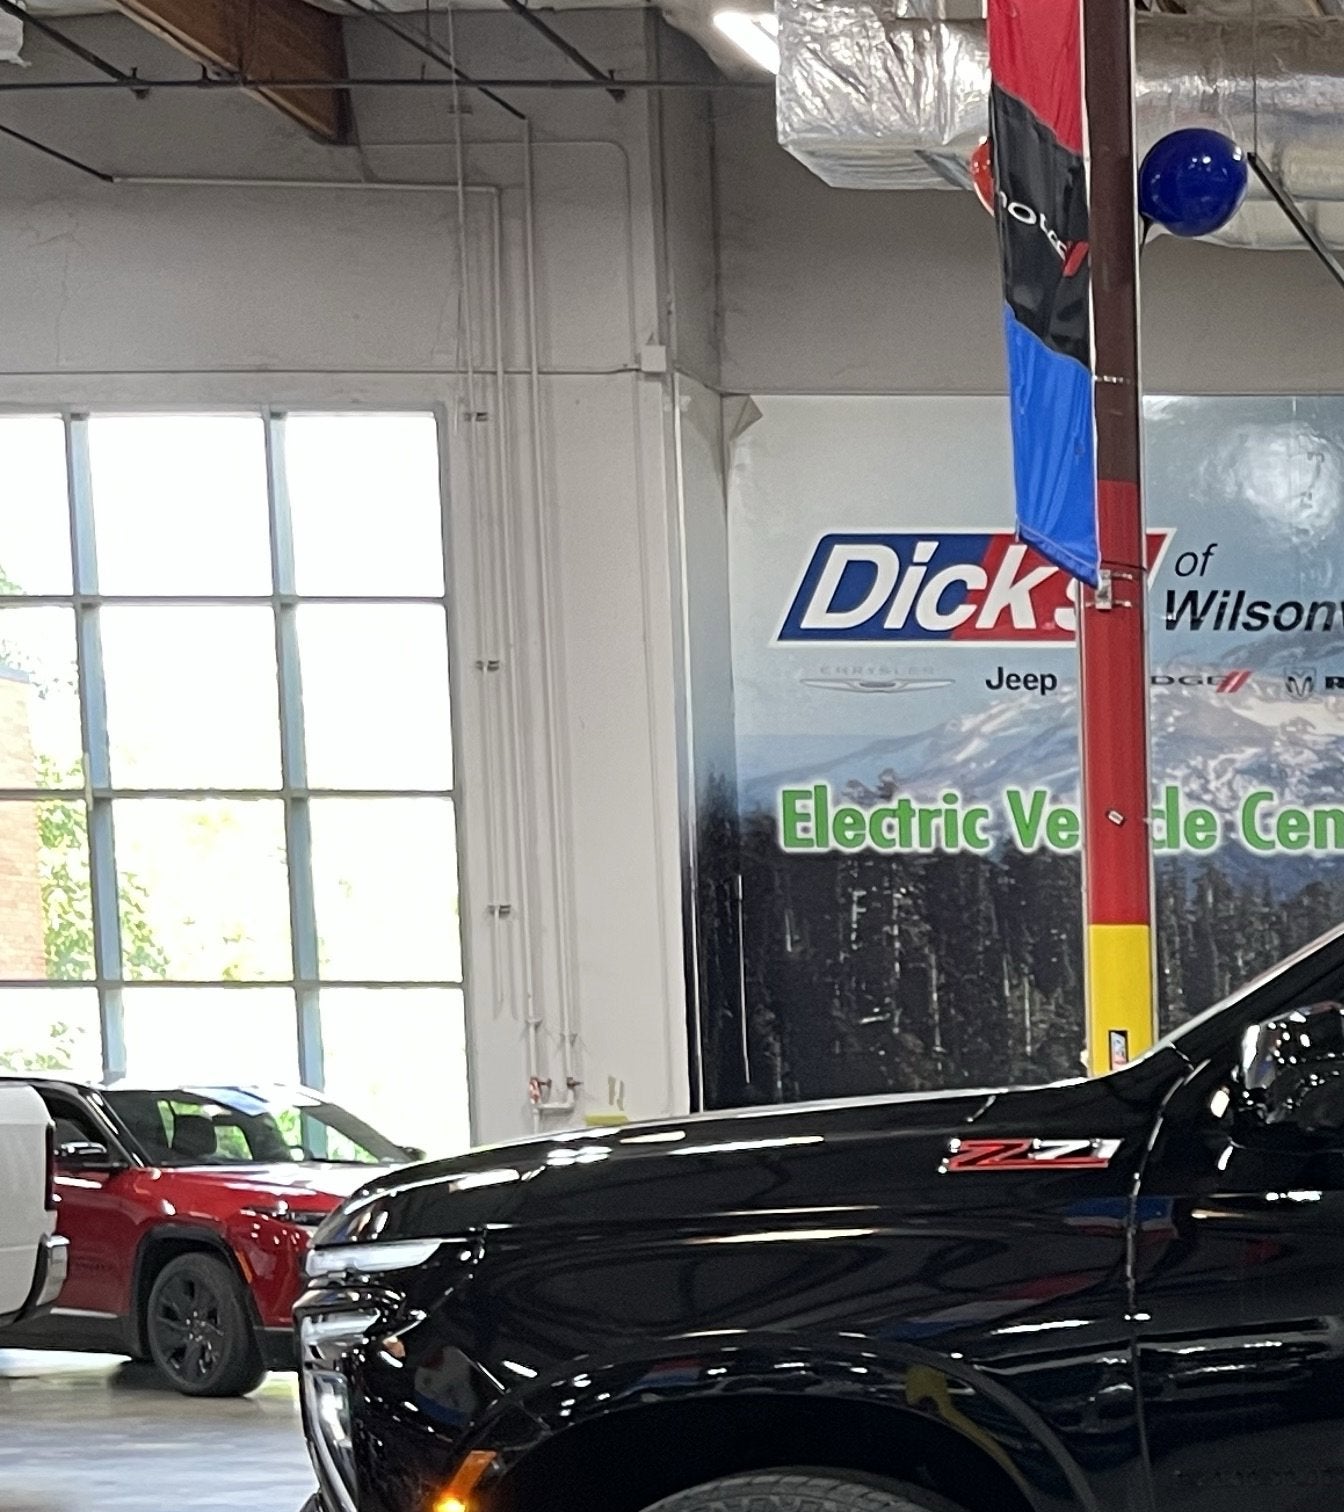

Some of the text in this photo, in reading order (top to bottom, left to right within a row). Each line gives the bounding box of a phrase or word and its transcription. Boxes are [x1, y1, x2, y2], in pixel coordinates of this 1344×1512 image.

[1174, 543, 1218, 577] of
[985, 666, 1058, 695] Jeep
[782, 784, 990, 850] Electric
[938, 1138, 1124, 1174] Z71
